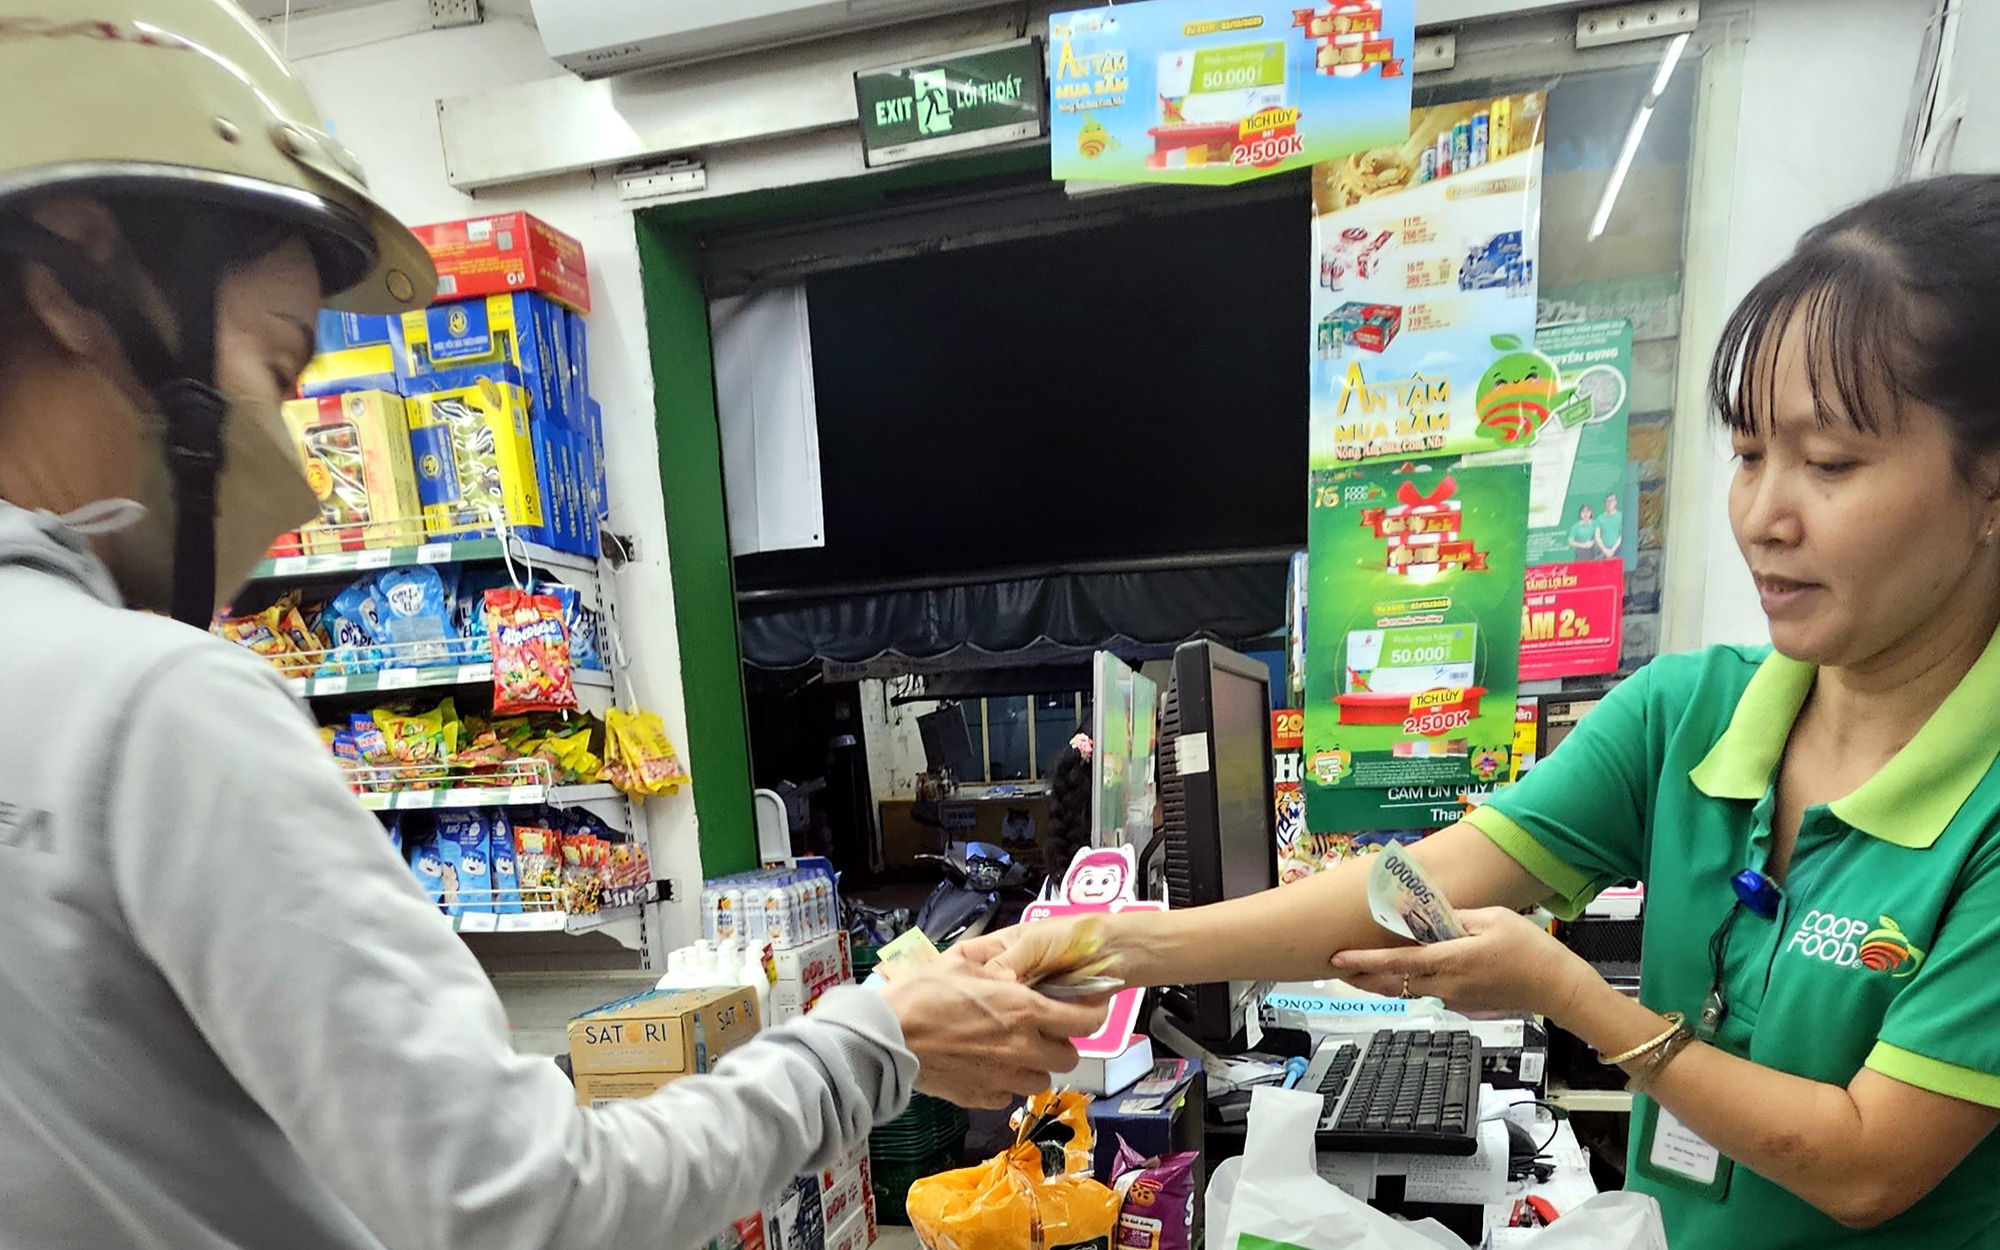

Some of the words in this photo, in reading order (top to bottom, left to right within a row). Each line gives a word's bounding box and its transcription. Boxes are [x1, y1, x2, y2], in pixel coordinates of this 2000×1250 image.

[1203, 67, 1256, 88] 50.000
[875, 96, 913, 126] EXIT
[980, 73, 1023, 103] THOÁT
[1234, 134, 1304, 165] 2.500K
[1335, 420, 1388, 443] MUA
[1521, 605, 1556, 641] ẢM
[1559, 608, 1590, 638] 2%
[1391, 646, 1446, 664] 50.000
[1416, 693, 1439, 706] TÍCH
[1403, 710, 1470, 734] 2.500K
[1274, 753, 1304, 783] H
[1430, 808, 1466, 821] Than
[1787, 930, 1858, 966] FOOD
